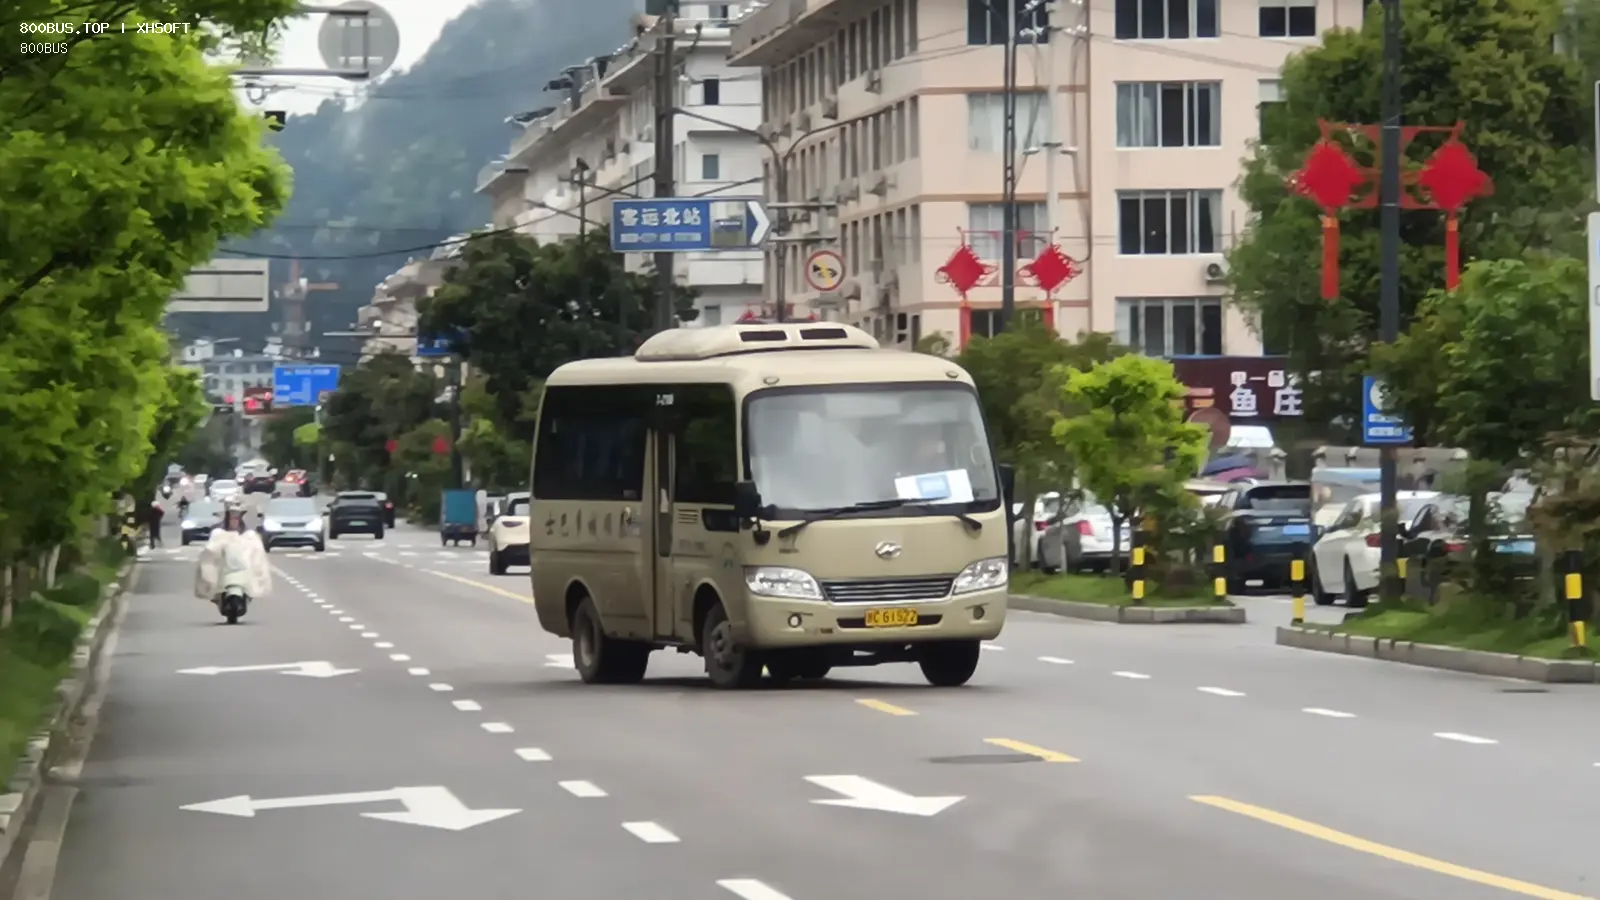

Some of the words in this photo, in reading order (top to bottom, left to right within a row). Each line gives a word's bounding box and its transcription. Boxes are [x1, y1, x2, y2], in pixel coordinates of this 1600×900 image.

[620, 207, 702, 226] 客运北站
[1229, 387, 1304, 417] 鱼庄
